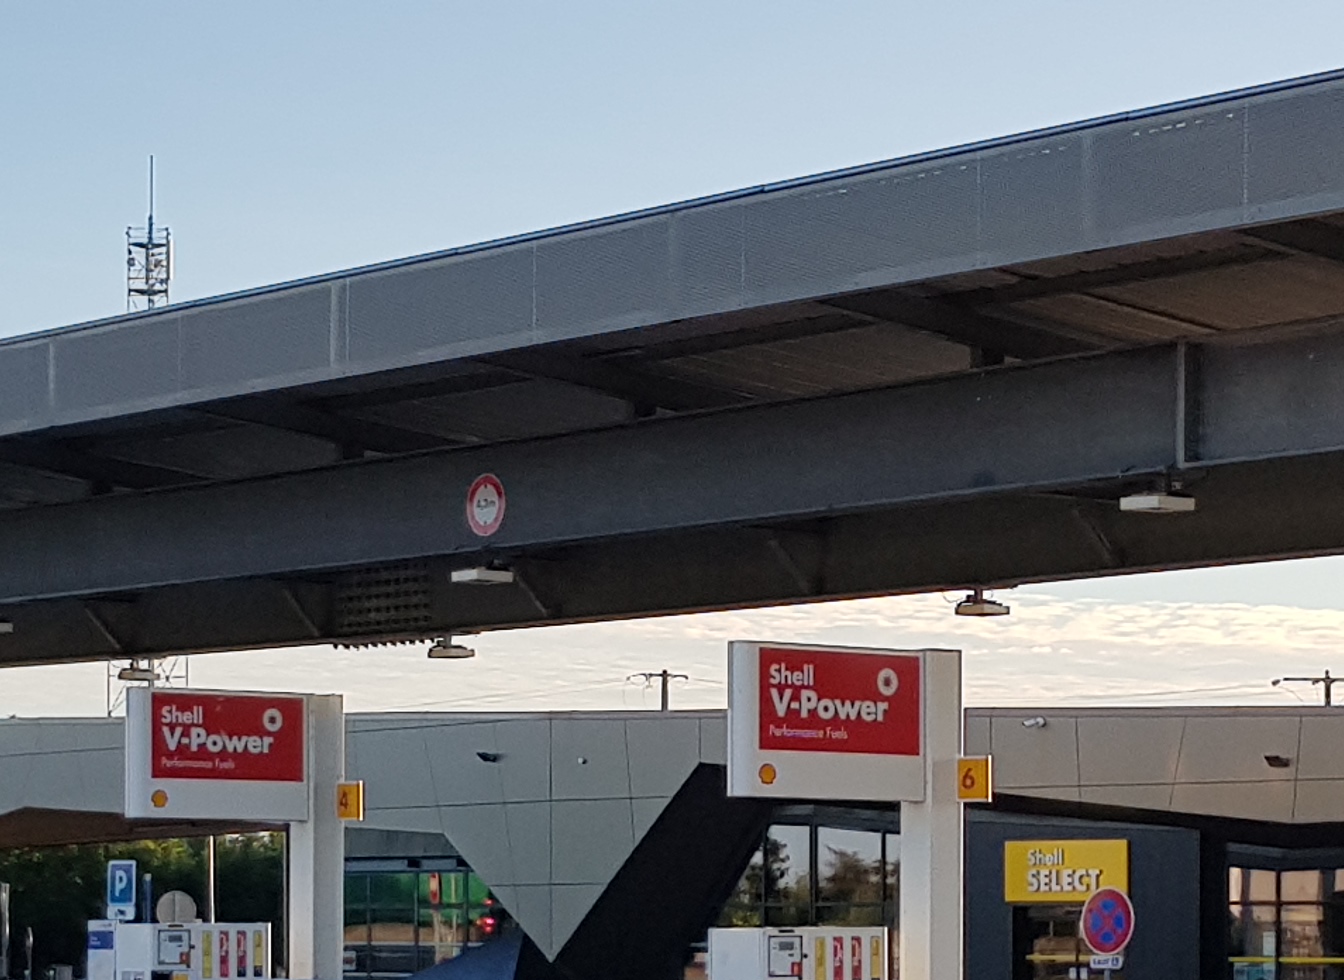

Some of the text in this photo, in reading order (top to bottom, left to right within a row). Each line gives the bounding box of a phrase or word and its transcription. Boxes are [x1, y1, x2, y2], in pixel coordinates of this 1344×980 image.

[769, 662, 814, 686] Shell
[161, 705, 203, 725] Shell
[770, 687, 889, 722] V-Power
[162, 726, 274, 753] V-Power
[826, 726, 848, 740] Fuels
[961, 767, 975, 790] 6
[339, 791, 348, 810] 4
[1028, 847, 1064, 866] Shell
[114, 869, 127, 897] P
[1027, 868, 1102, 892] SELECT
